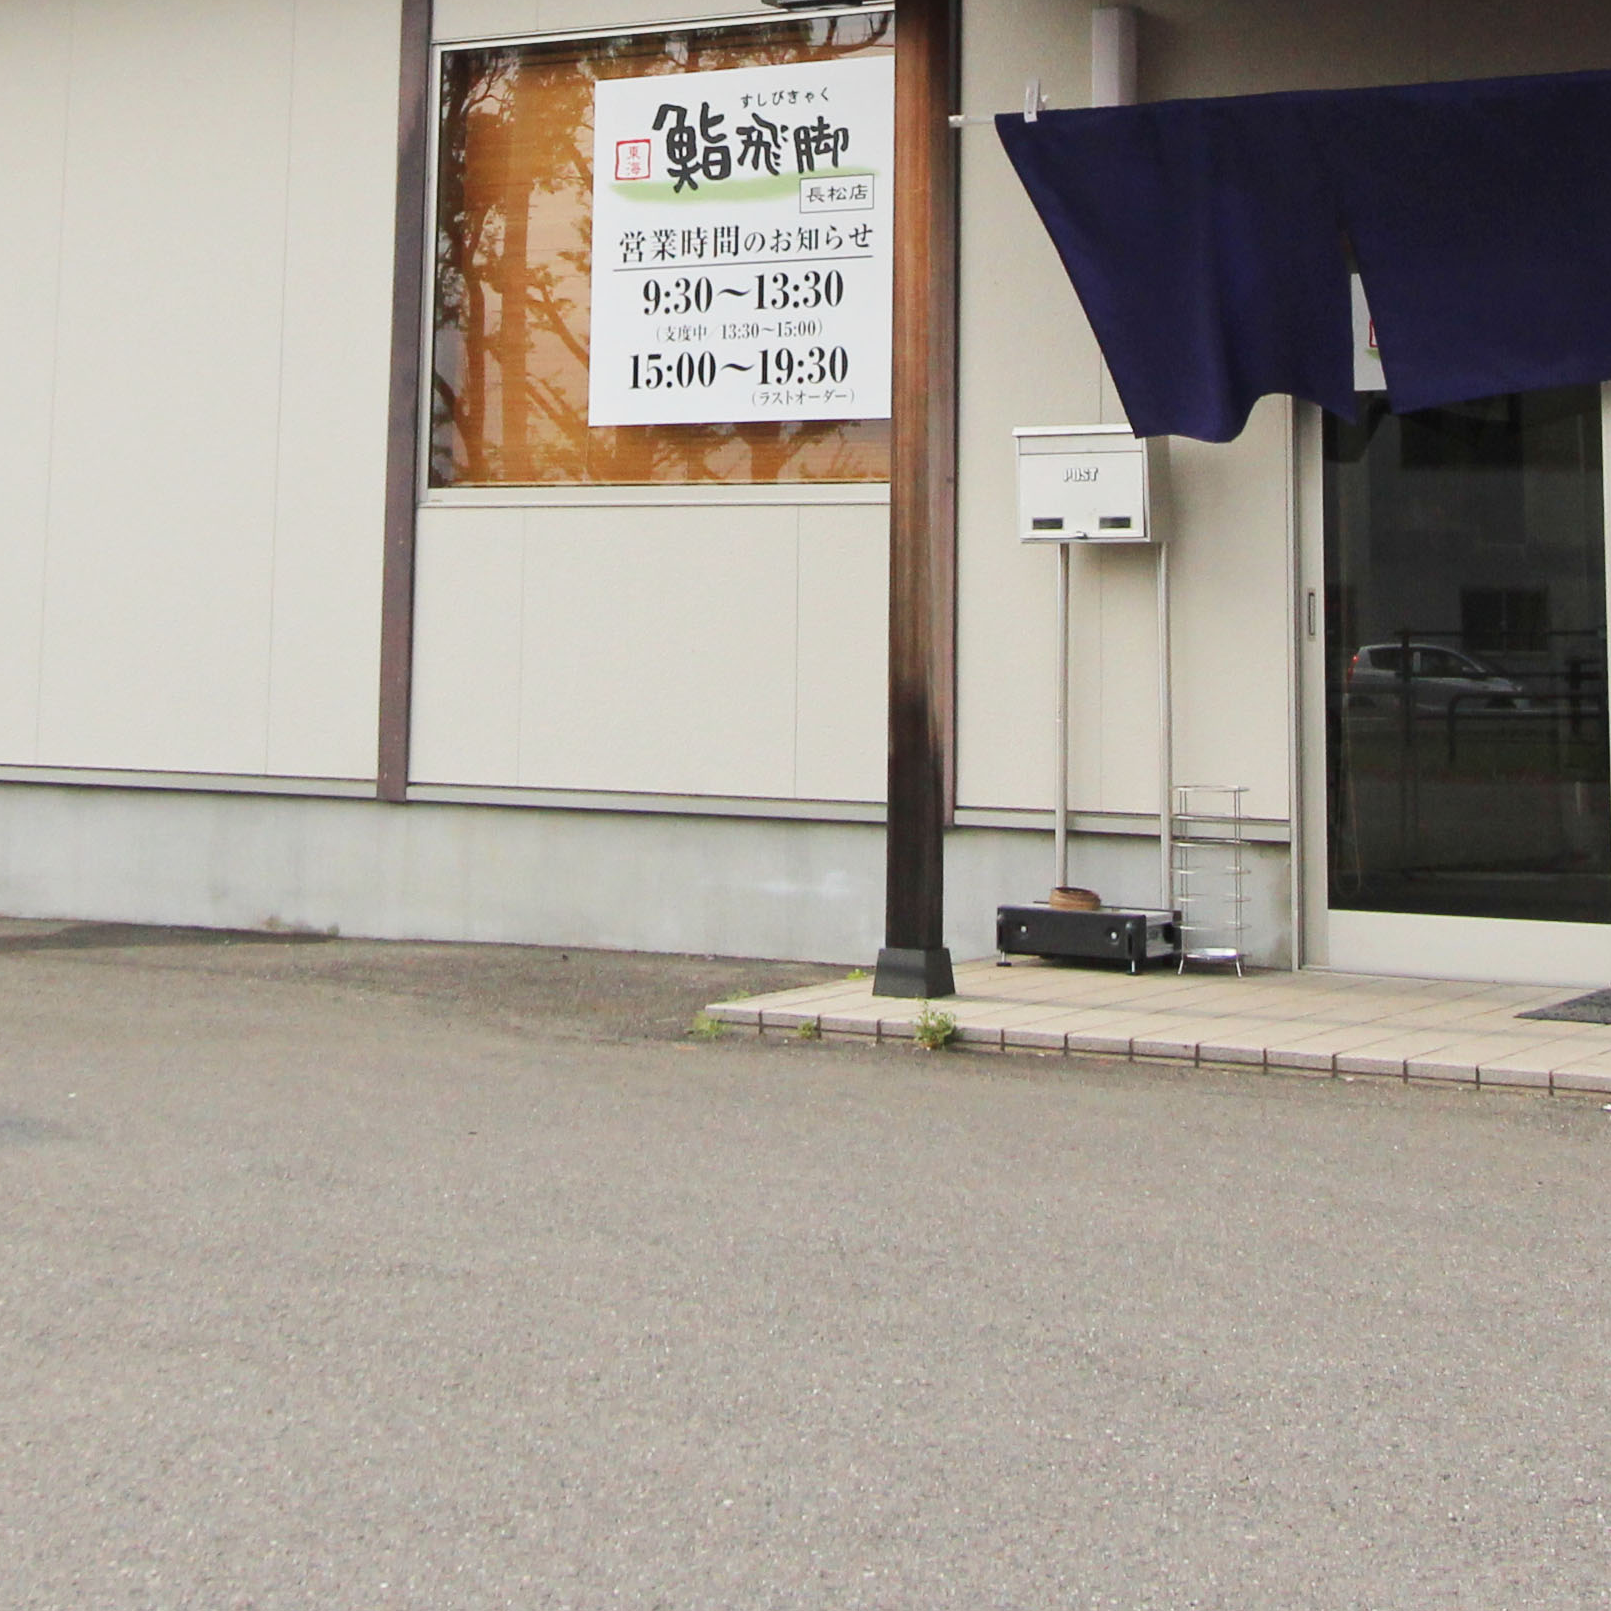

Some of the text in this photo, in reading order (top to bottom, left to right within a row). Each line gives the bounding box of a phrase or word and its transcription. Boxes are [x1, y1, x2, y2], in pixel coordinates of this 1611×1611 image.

[741, 87, 829, 108] すしびきゃく
[652, 102, 849, 194] 鮨飛脚
[806, 184, 869, 203] 長松店
[619, 224, 873, 263] 営業時間のお知らせ
